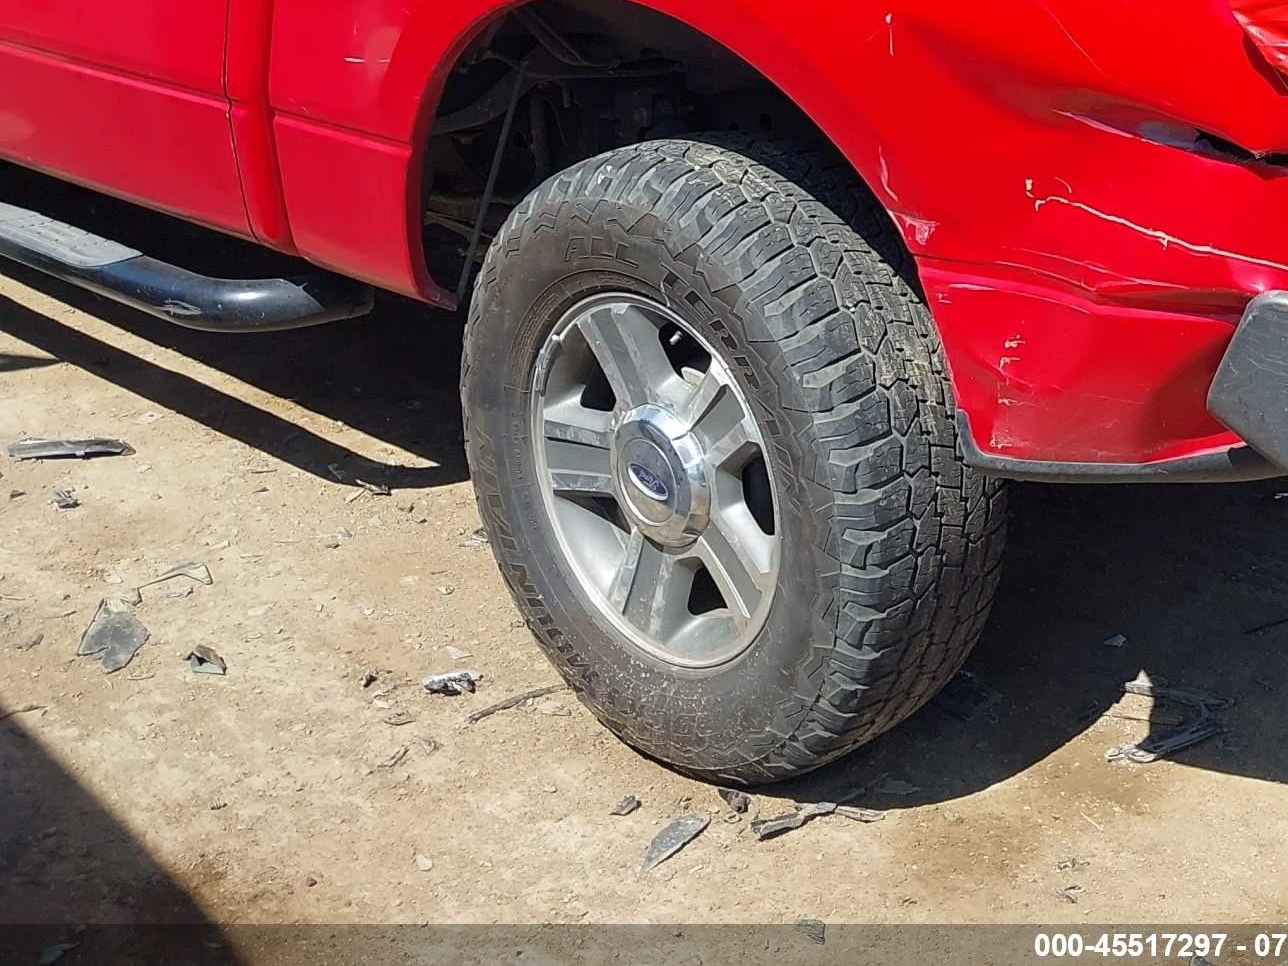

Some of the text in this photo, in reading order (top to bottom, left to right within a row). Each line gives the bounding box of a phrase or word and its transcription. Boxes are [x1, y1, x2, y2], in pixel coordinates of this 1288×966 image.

[564, 236, 805, 509] ALL TERRAIN
[637, 469, 660, 491] Ford
